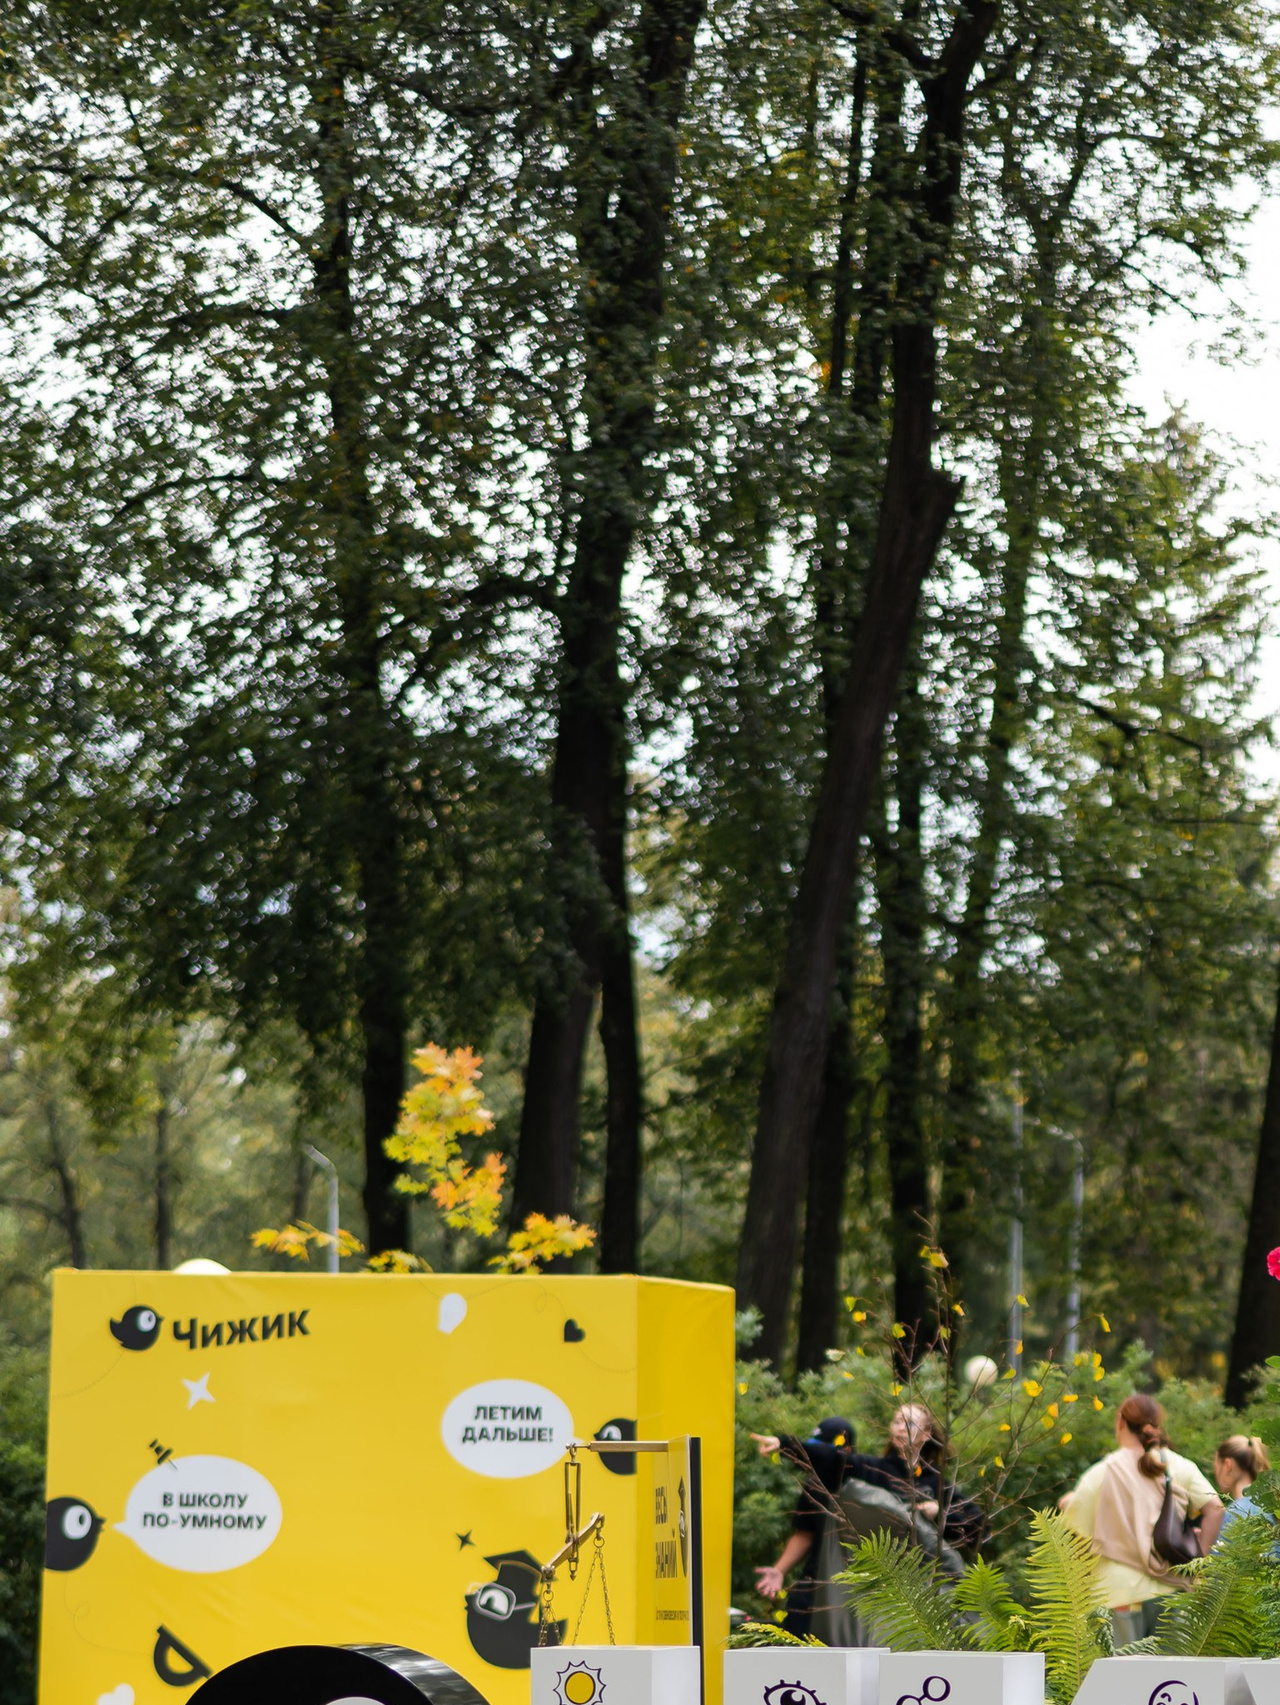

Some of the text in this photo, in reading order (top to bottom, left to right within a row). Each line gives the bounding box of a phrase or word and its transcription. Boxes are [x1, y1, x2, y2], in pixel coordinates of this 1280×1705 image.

[475, 1405, 543, 1420] ЛЕТИМ
[462, 1427, 554, 1443] ДАЛЬШЕ!
[163, 1493, 248, 1508] В ШКОЛУ
[143, 1513, 268, 1529] ПО-УМНОМУ
